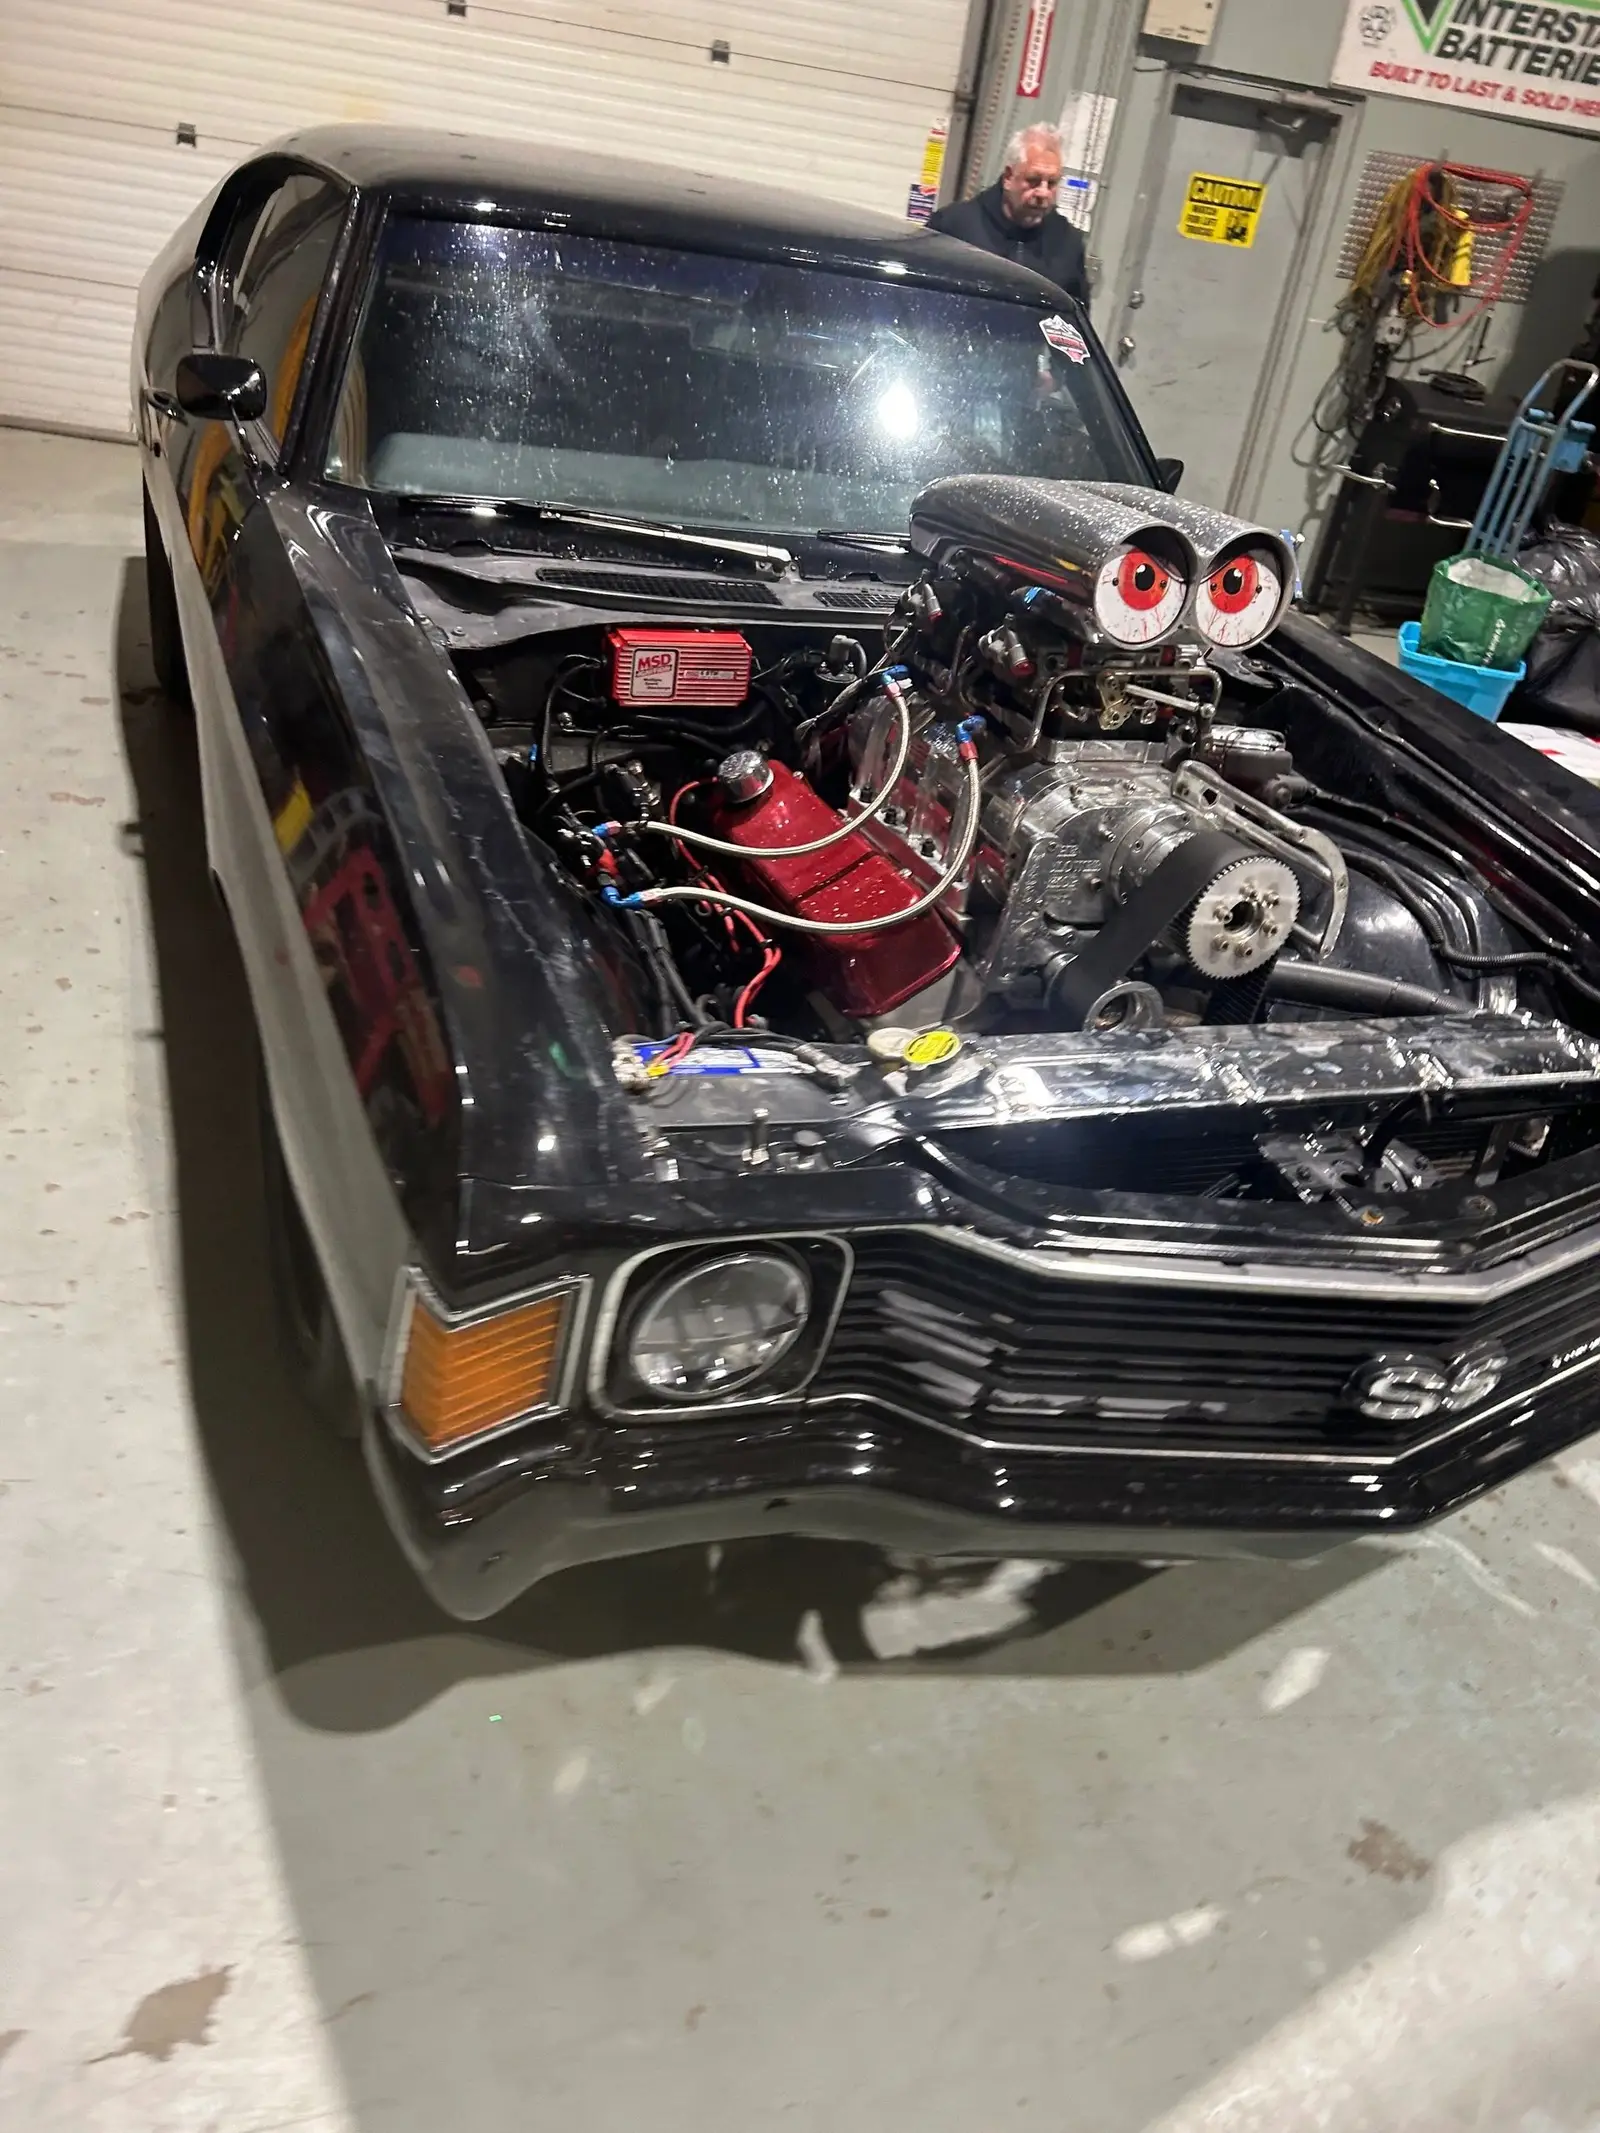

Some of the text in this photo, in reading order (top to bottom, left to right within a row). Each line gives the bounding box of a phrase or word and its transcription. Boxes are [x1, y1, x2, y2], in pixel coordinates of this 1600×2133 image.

[1370, 61, 1424, 84] BUILT
[1426, 71, 1451, 89] TO
[1452, 76, 1503, 99] LAST
[1521, 88, 1570, 111] SOLD
[637, 654, 672, 671] MSD
[1358, 1352, 1508, 1420] SS
